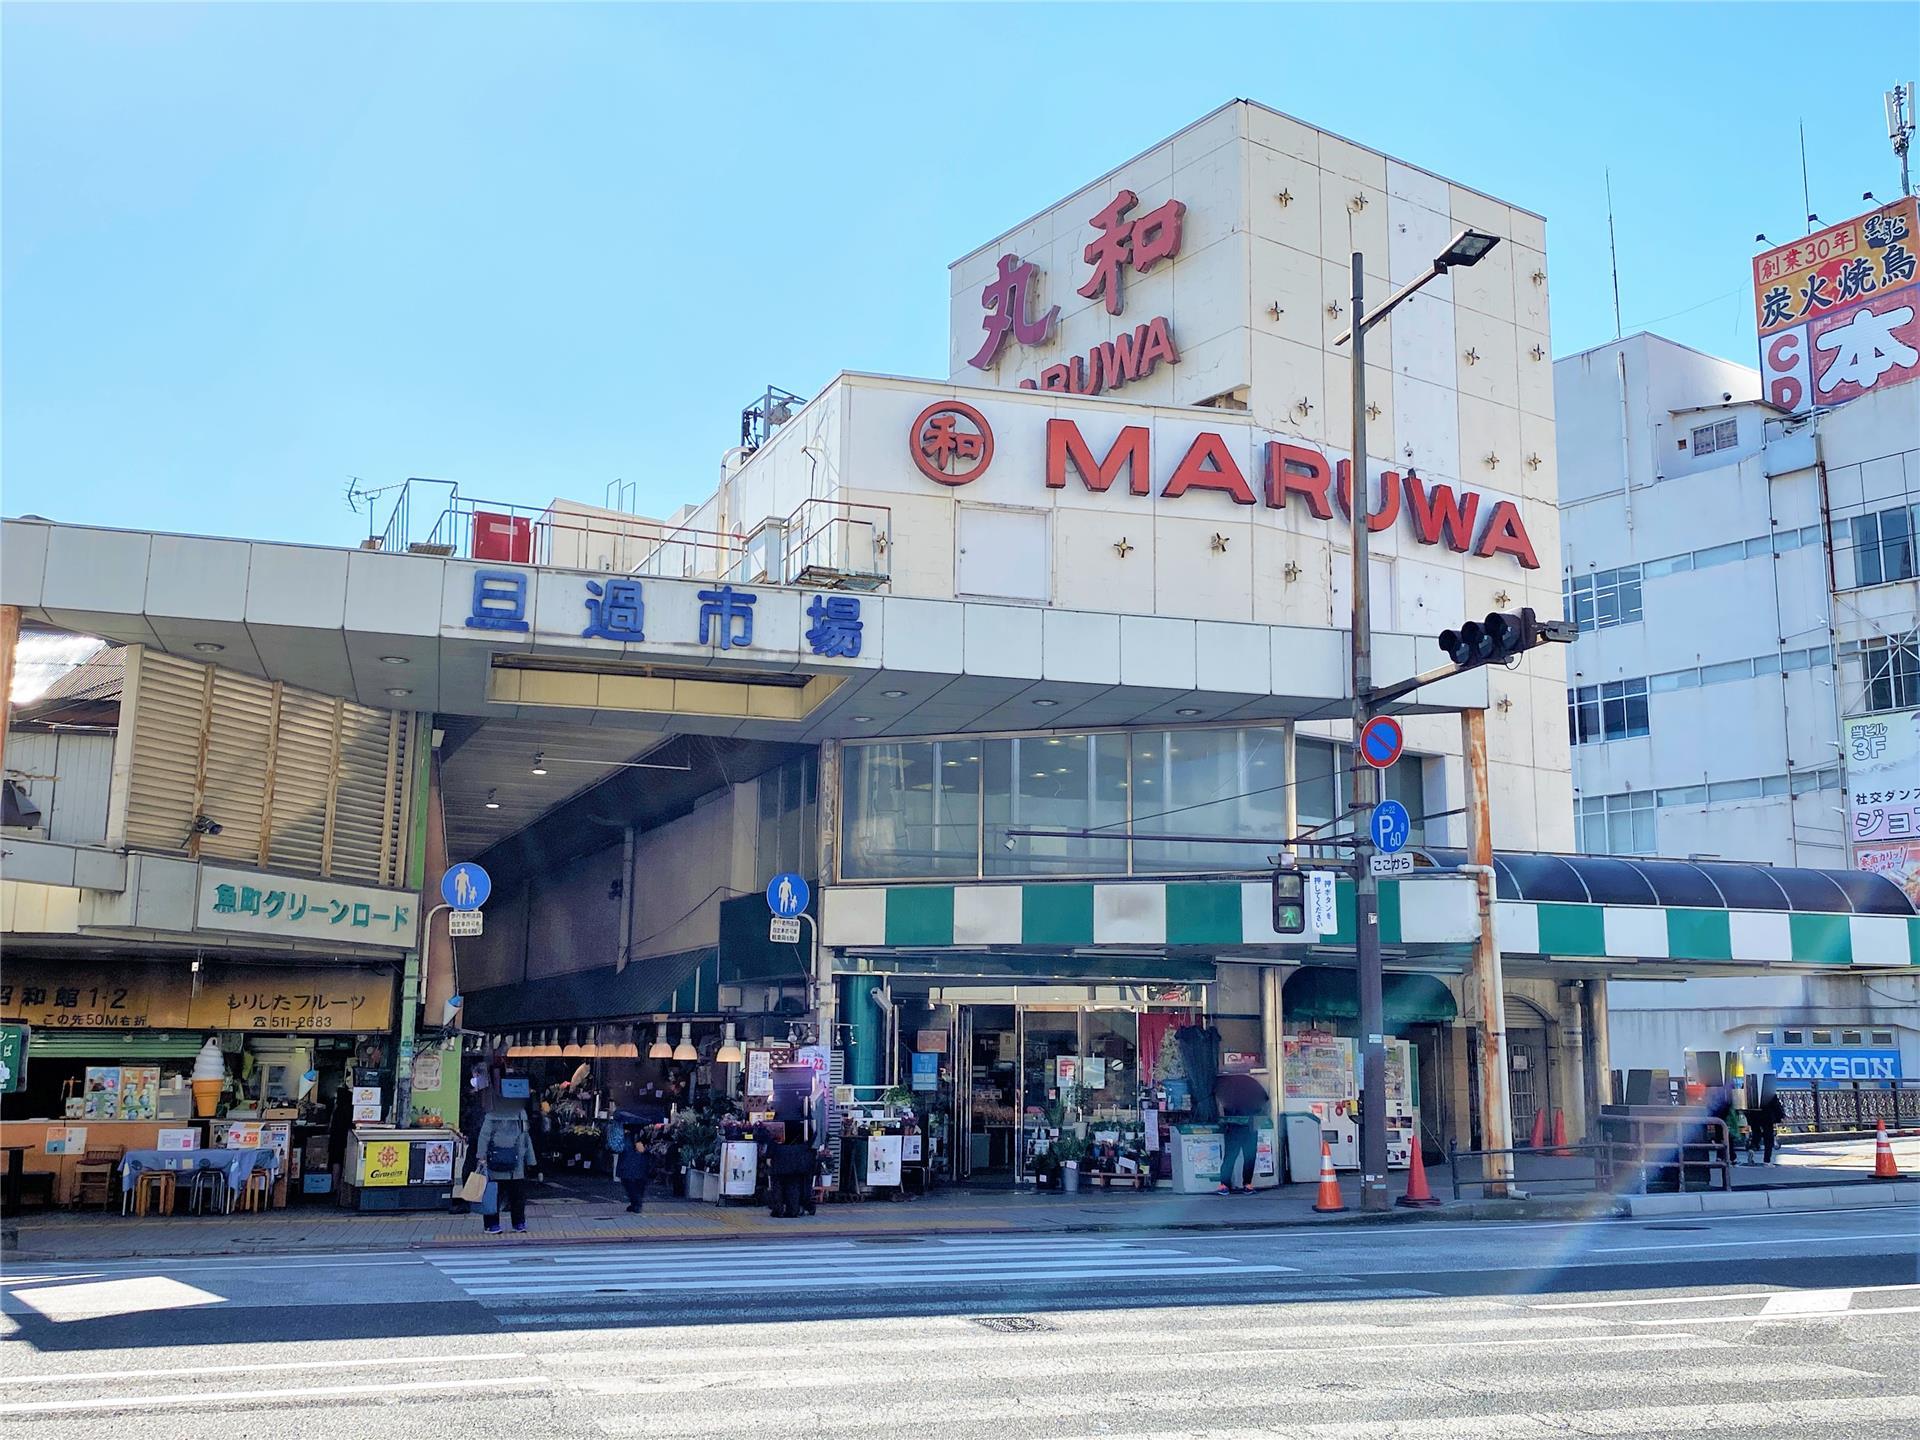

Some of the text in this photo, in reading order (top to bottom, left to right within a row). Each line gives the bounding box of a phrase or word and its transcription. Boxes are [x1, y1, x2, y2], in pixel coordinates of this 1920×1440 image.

[1762, 230, 1853, 281] 創業30年
[968, 190, 1187, 370] 丸和
[1761, 244, 1916, 327] 炭火焼鳥
[1815, 305, 1919, 394] 本
[1045, 418, 1541, 570] MARUWA
[465, 569, 863, 658] 旦過市場
[1852, 723, 1888, 739] 当ビル
[1852, 736, 1886, 761] 3F
[1379, 815, 1394, 848] P
[1390, 831, 1402, 847] 60
[1856, 807, 1920, 836] ジョ
[1374, 857, 1410, 871] ここから
[213, 884, 409, 932] 魚町グリーンロード
[228, 993, 366, 1011] もりしたフルーツ
[272, 1016, 332, 1028] 511-2683
[1777, 1056, 1896, 1079] AWSON
